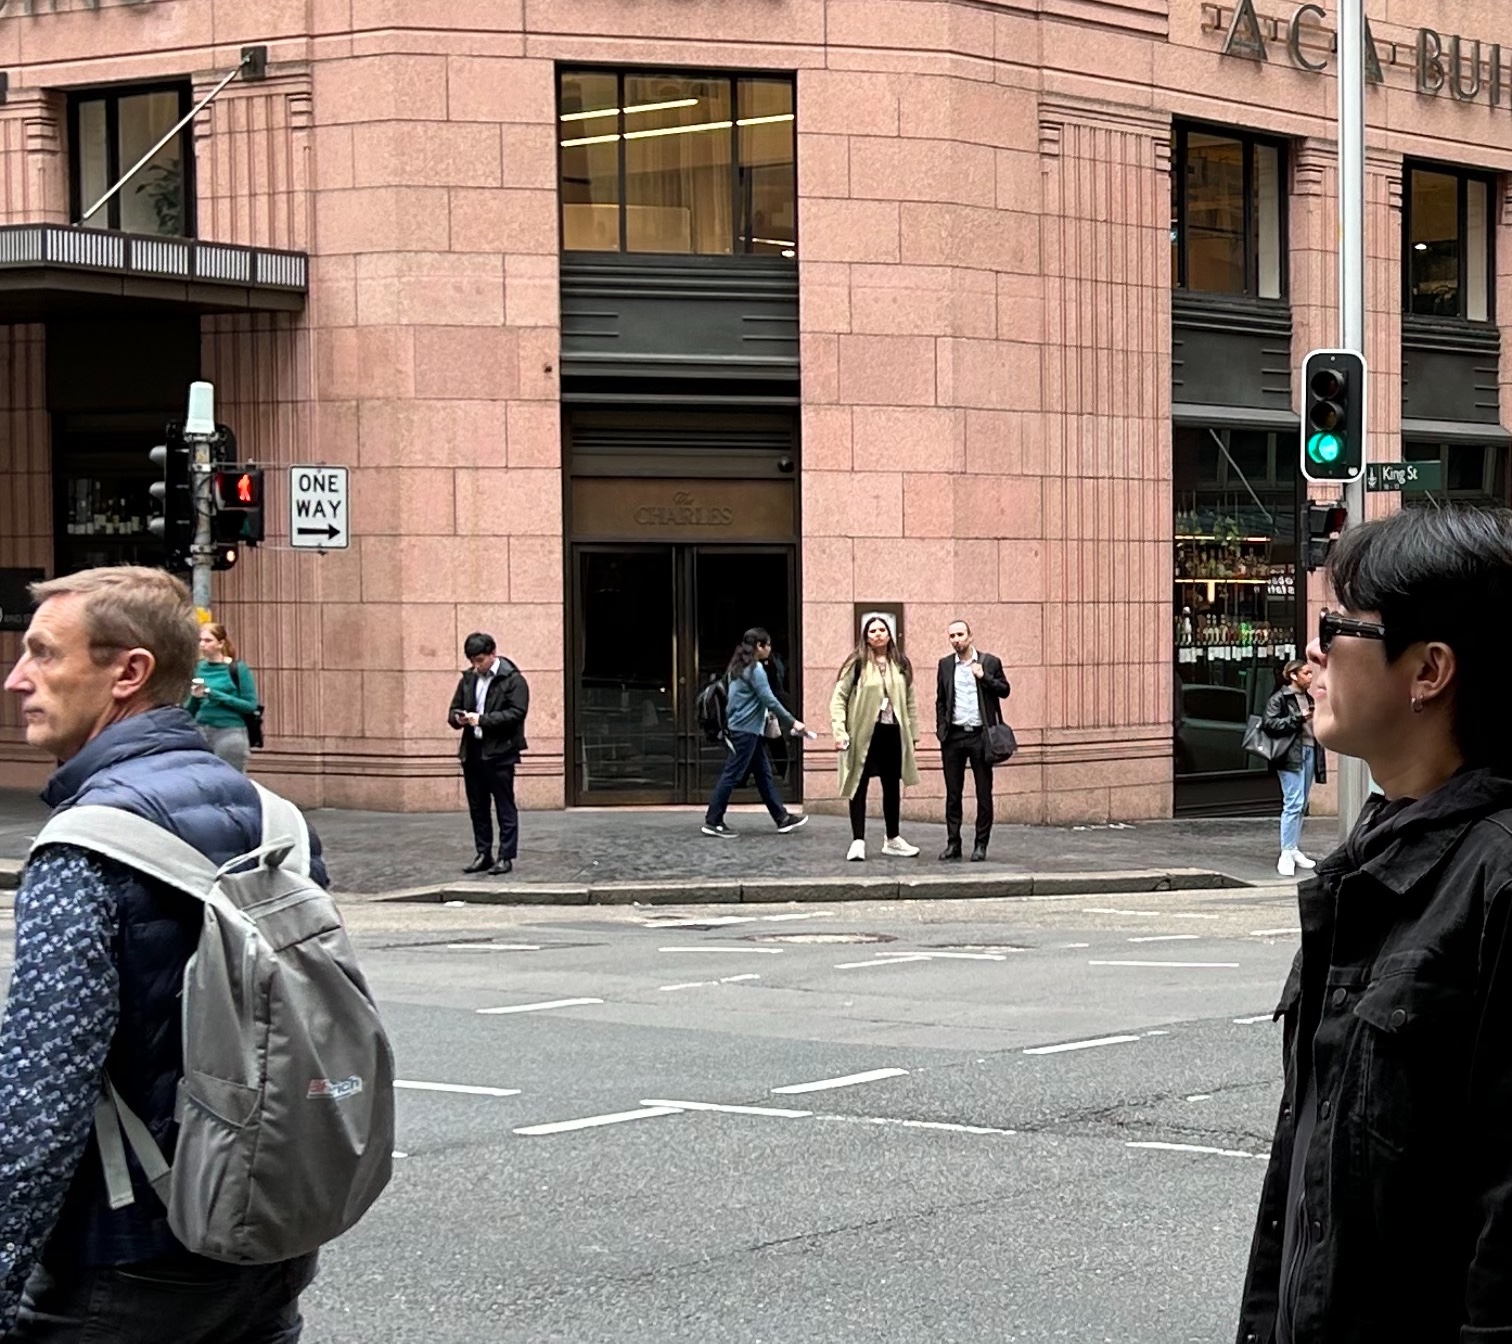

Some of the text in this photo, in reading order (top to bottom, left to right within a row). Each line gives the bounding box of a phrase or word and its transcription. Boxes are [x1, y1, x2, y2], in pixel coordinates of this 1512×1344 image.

[298, 474, 339, 493] ONE
[1382, 465, 1418, 485] King St
[296, 499, 341, 518] WAY
[633, 506, 733, 526] CHARLES
